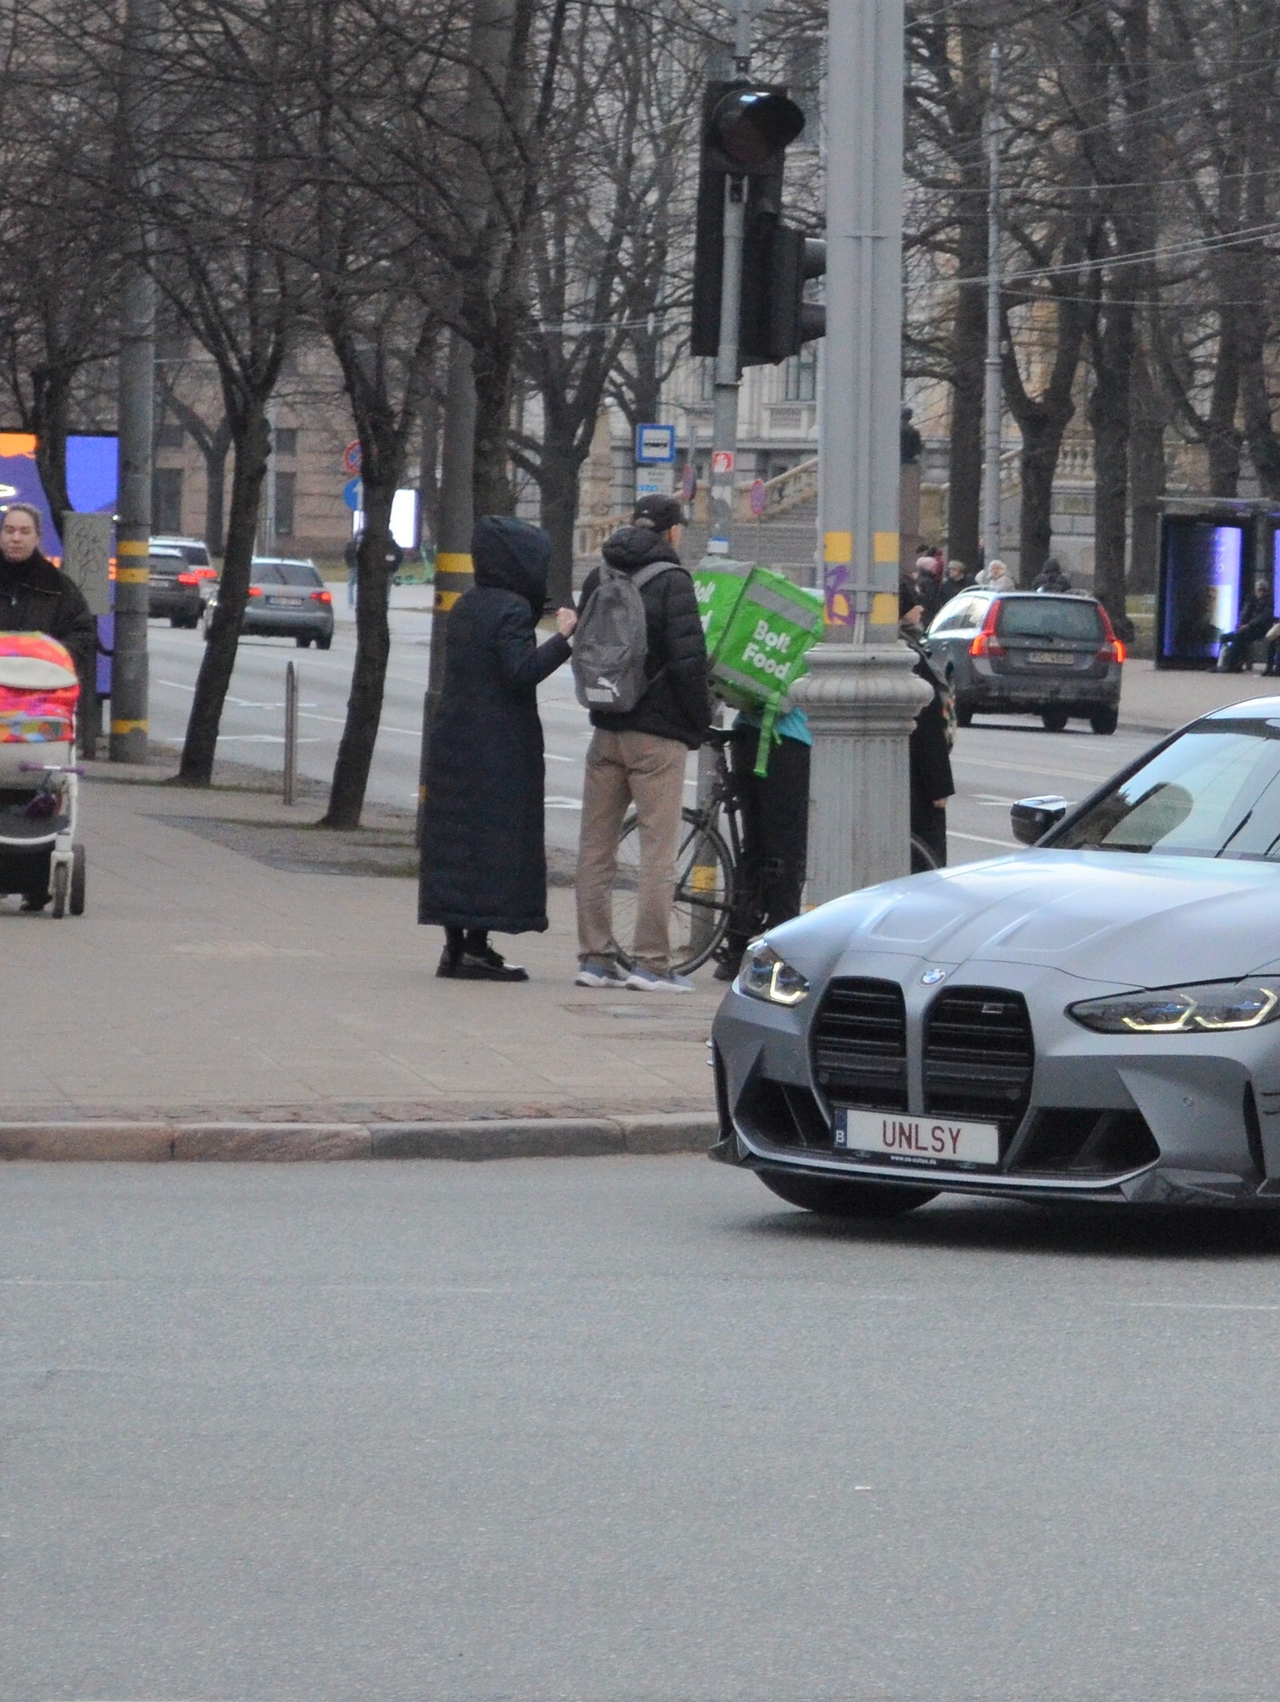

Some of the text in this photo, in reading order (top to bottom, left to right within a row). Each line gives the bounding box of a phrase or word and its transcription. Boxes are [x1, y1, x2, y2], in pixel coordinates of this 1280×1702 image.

[752, 620, 791, 653] Bolt
[742, 642, 791, 680] Food
[836, 1130, 845, 1143] B
[882, 1120, 962, 1154] UNLSY
